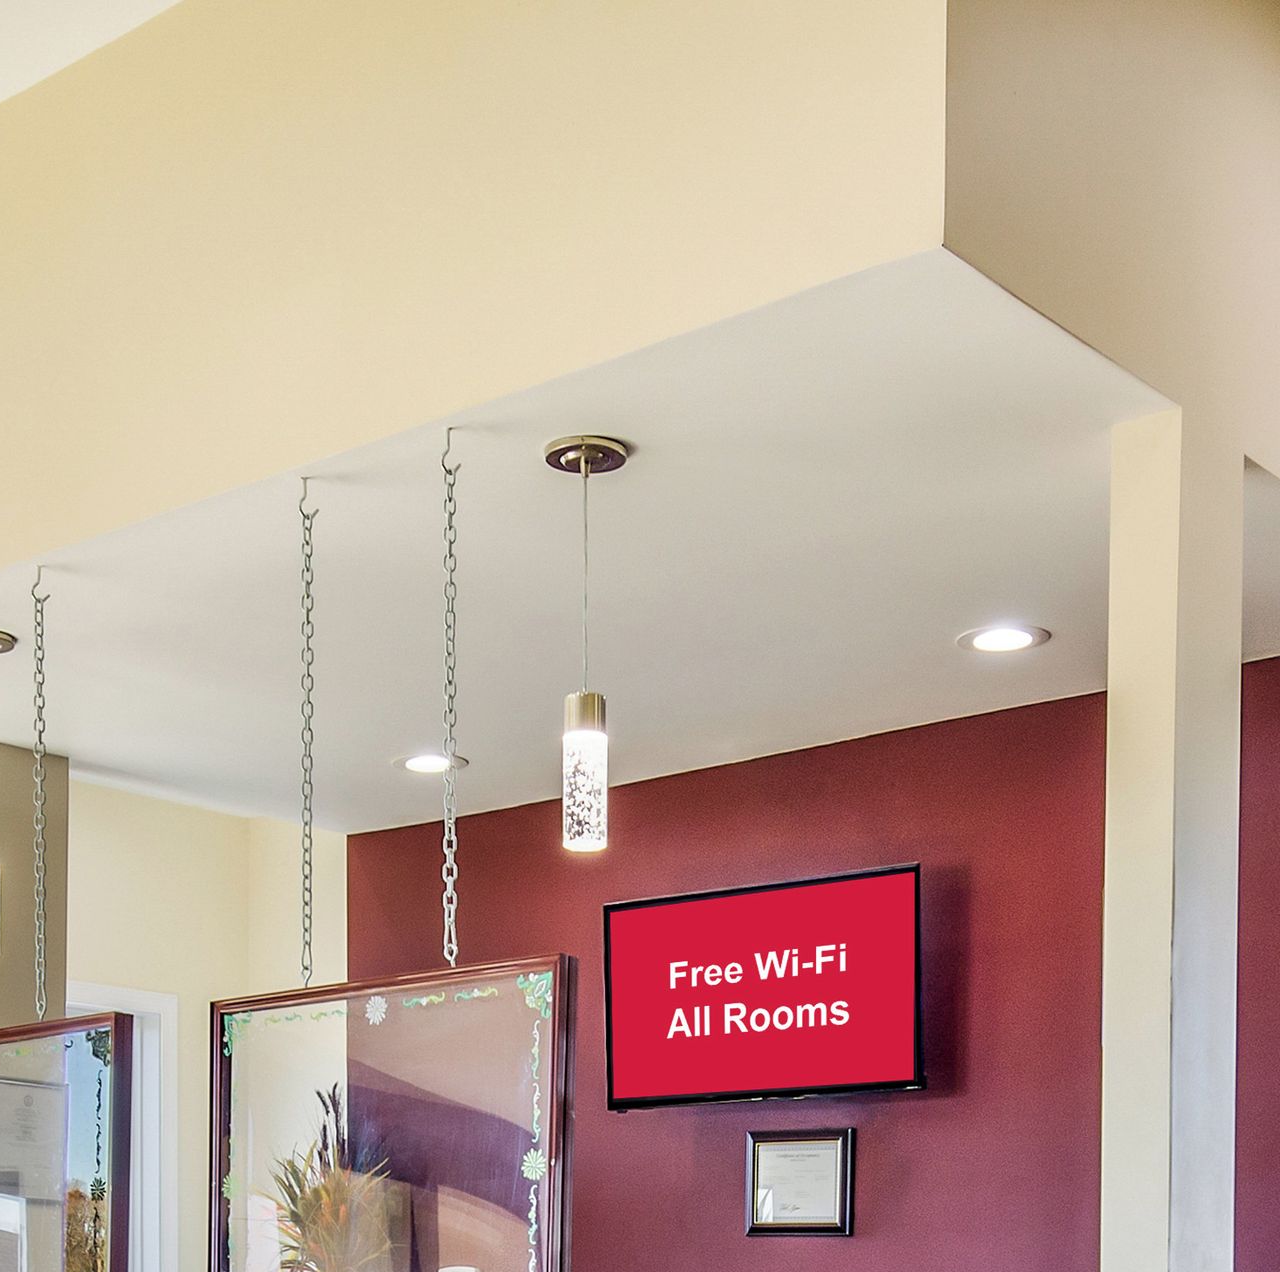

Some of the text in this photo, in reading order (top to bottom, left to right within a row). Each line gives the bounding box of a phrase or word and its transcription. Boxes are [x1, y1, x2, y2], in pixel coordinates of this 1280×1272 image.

[669, 943, 847, 990] Free Wi-Fi
[666, 1000, 850, 1039] All Rooms
